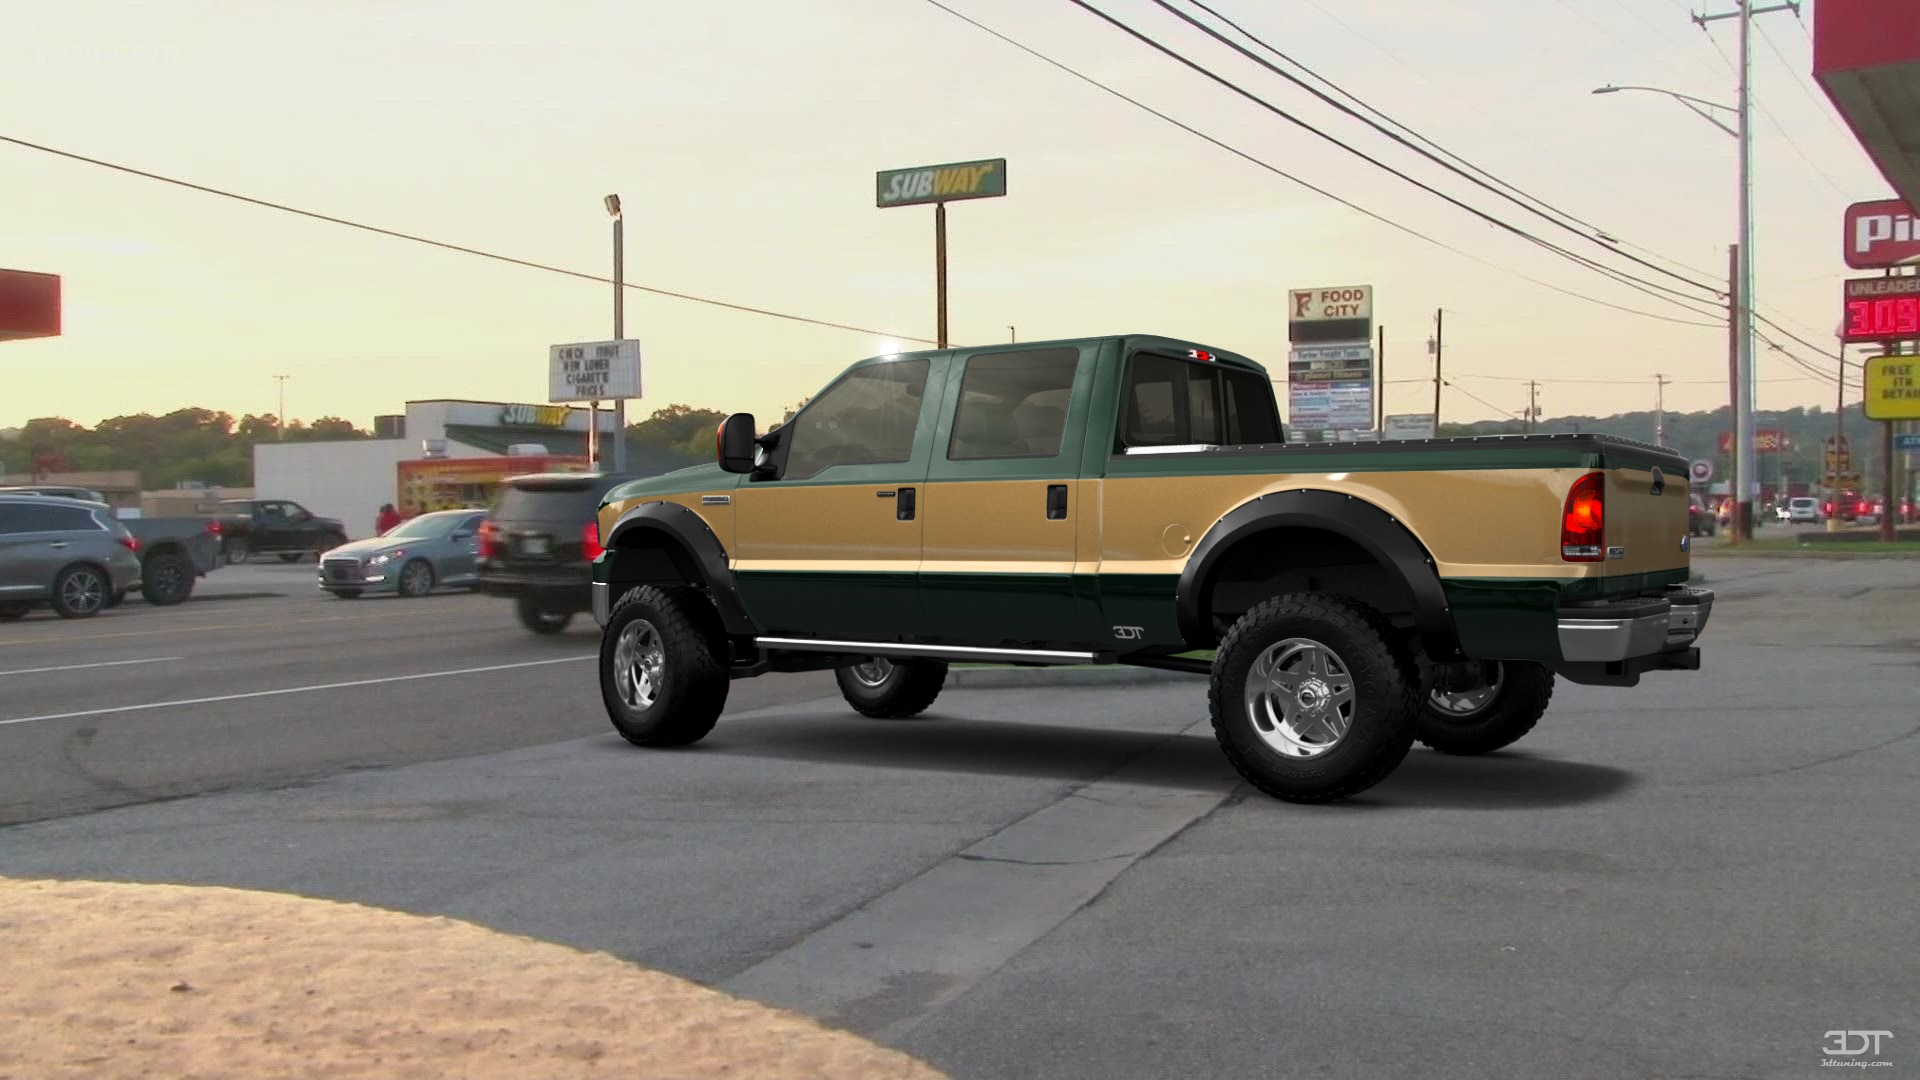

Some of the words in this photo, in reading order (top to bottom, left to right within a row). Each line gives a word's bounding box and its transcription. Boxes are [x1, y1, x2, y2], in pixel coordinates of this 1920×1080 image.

[882, 163, 994, 200] SUBWAY
[1321, 289, 1364, 303] FOOD
[1323, 304, 1360, 318] CITY
[505, 405, 571, 425] SUBWAY
